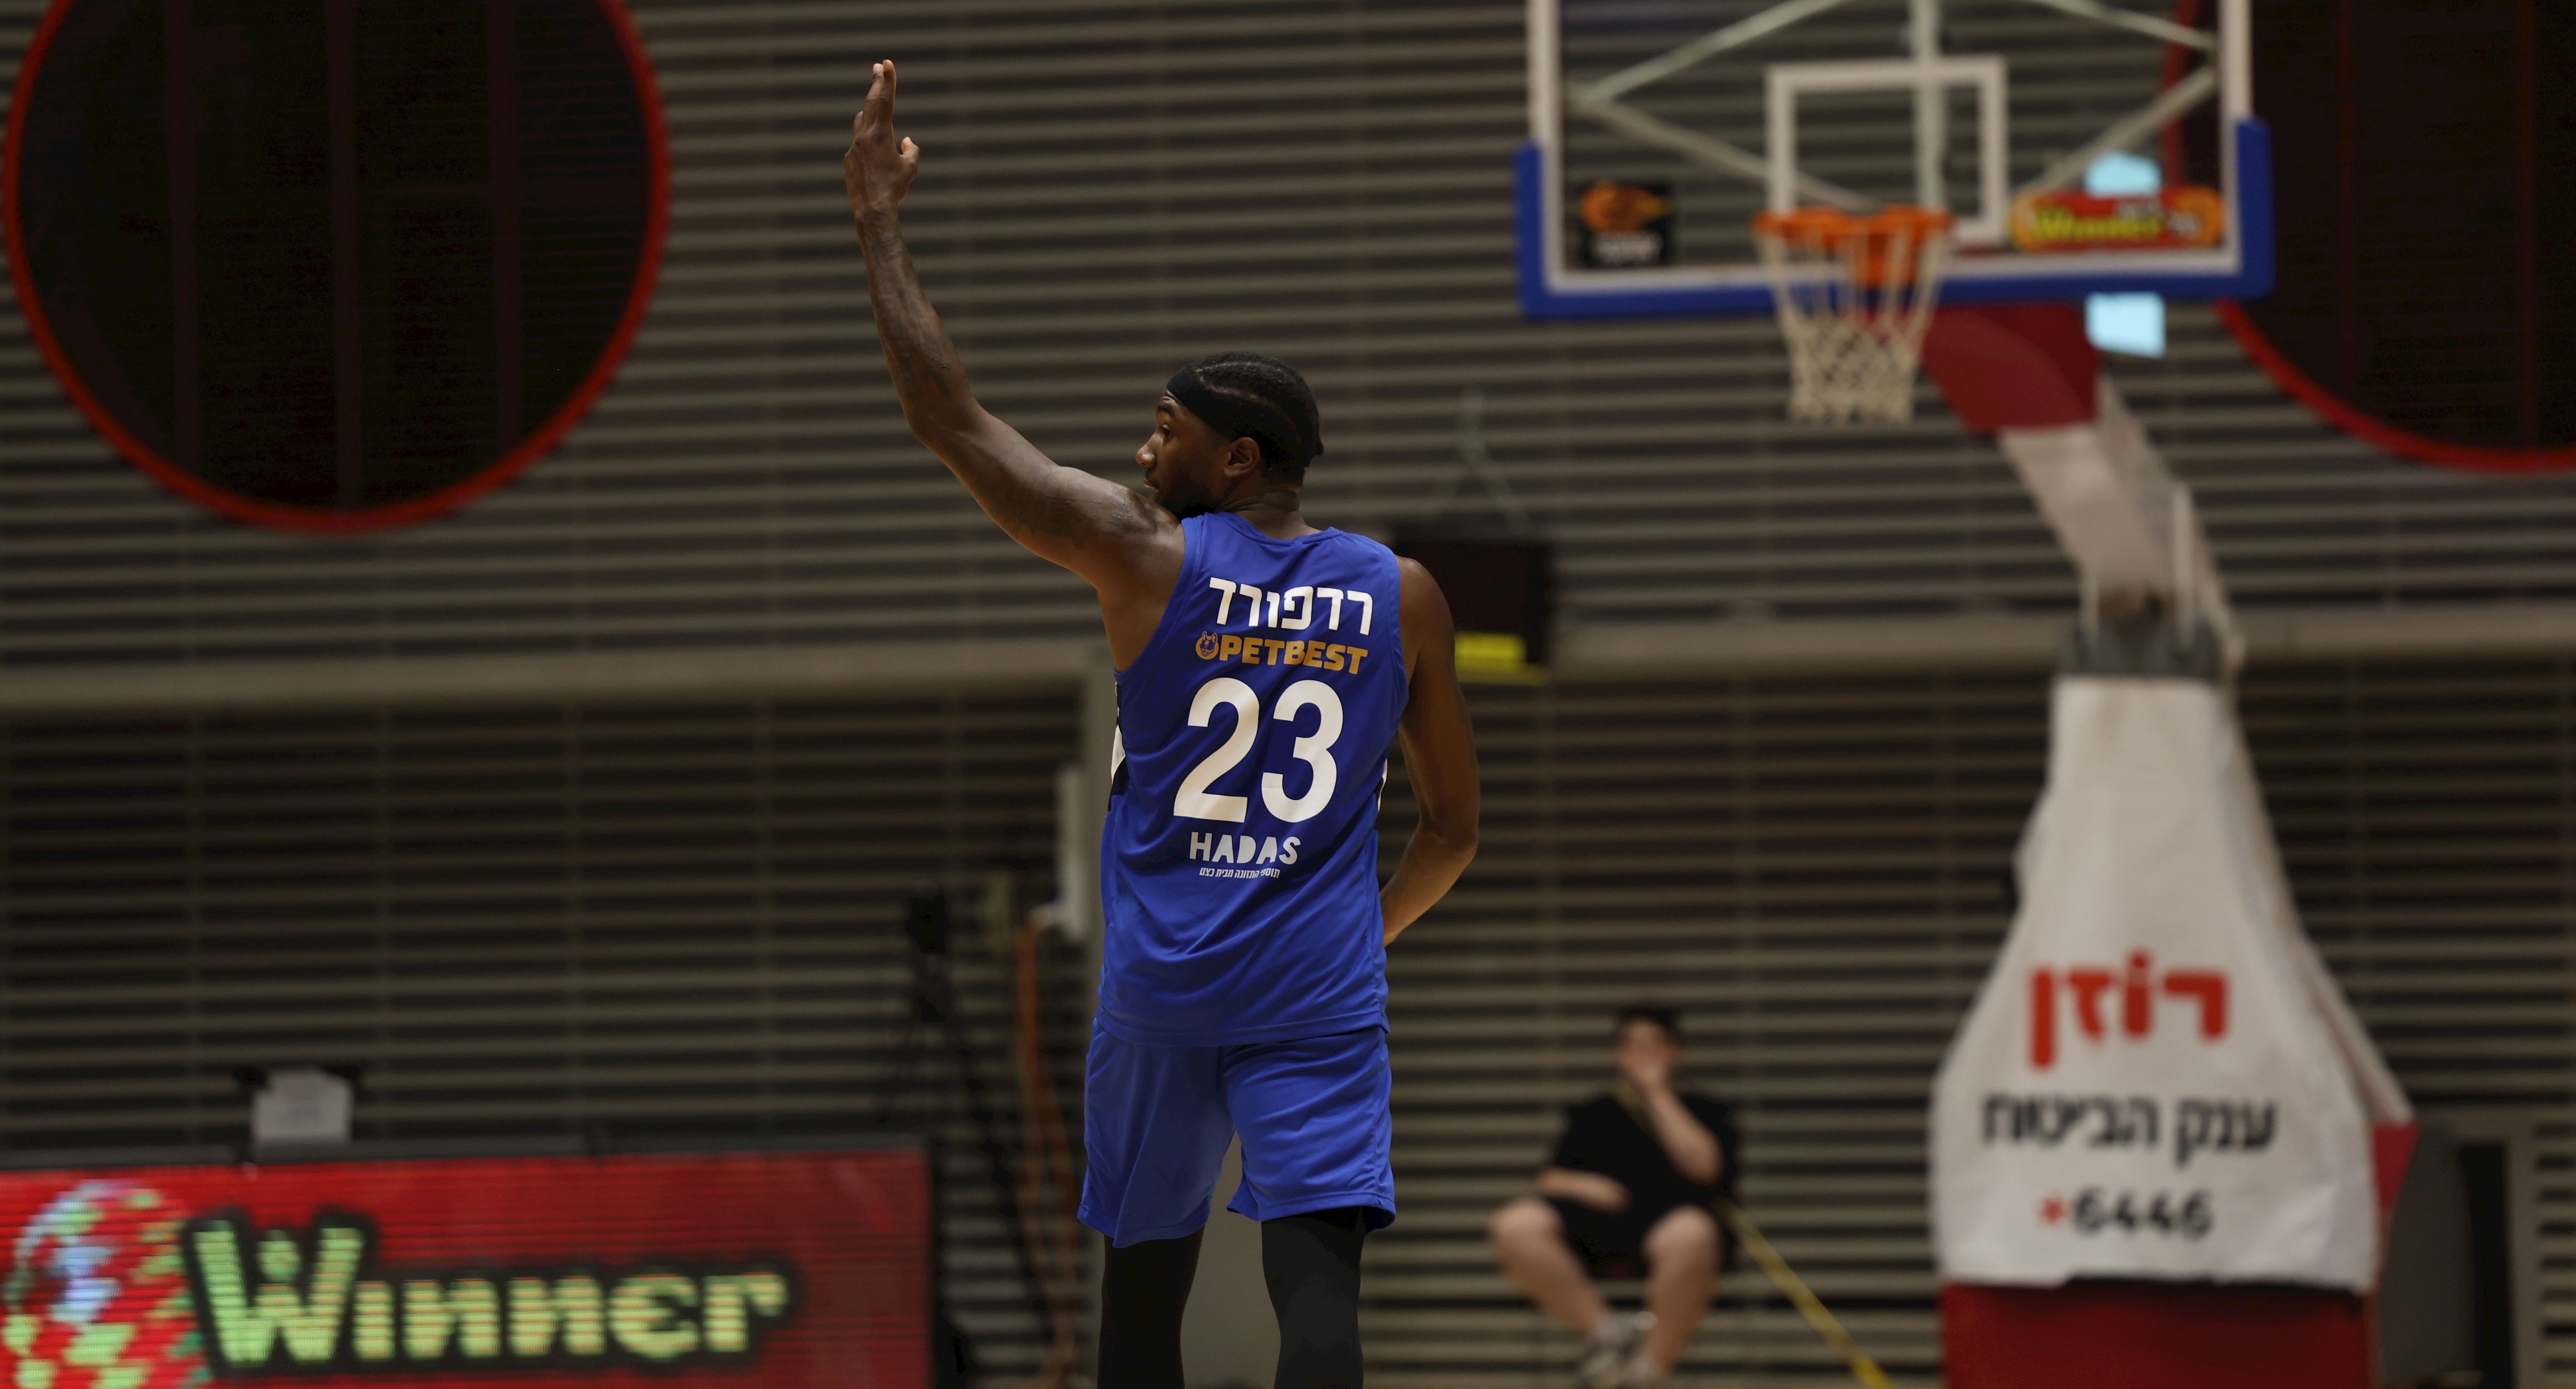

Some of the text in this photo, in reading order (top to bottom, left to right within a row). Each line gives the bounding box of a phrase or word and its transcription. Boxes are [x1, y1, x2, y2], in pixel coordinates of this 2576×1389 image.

[1209, 577, 1373, 635] רדפורד
[1219, 633, 1368, 674] PETBEST
[1173, 677, 1343, 823] 23
[1189, 831, 1301, 865] HADAS
[1215, 868, 1234, 878] מבית
[1234, 869, 1260, 879] התזונה
[2031, 950, 2228, 1069] רוזן
[1982, 1093, 2275, 1168] ענק הביטוח
[195, 1221, 787, 1363] Winner
